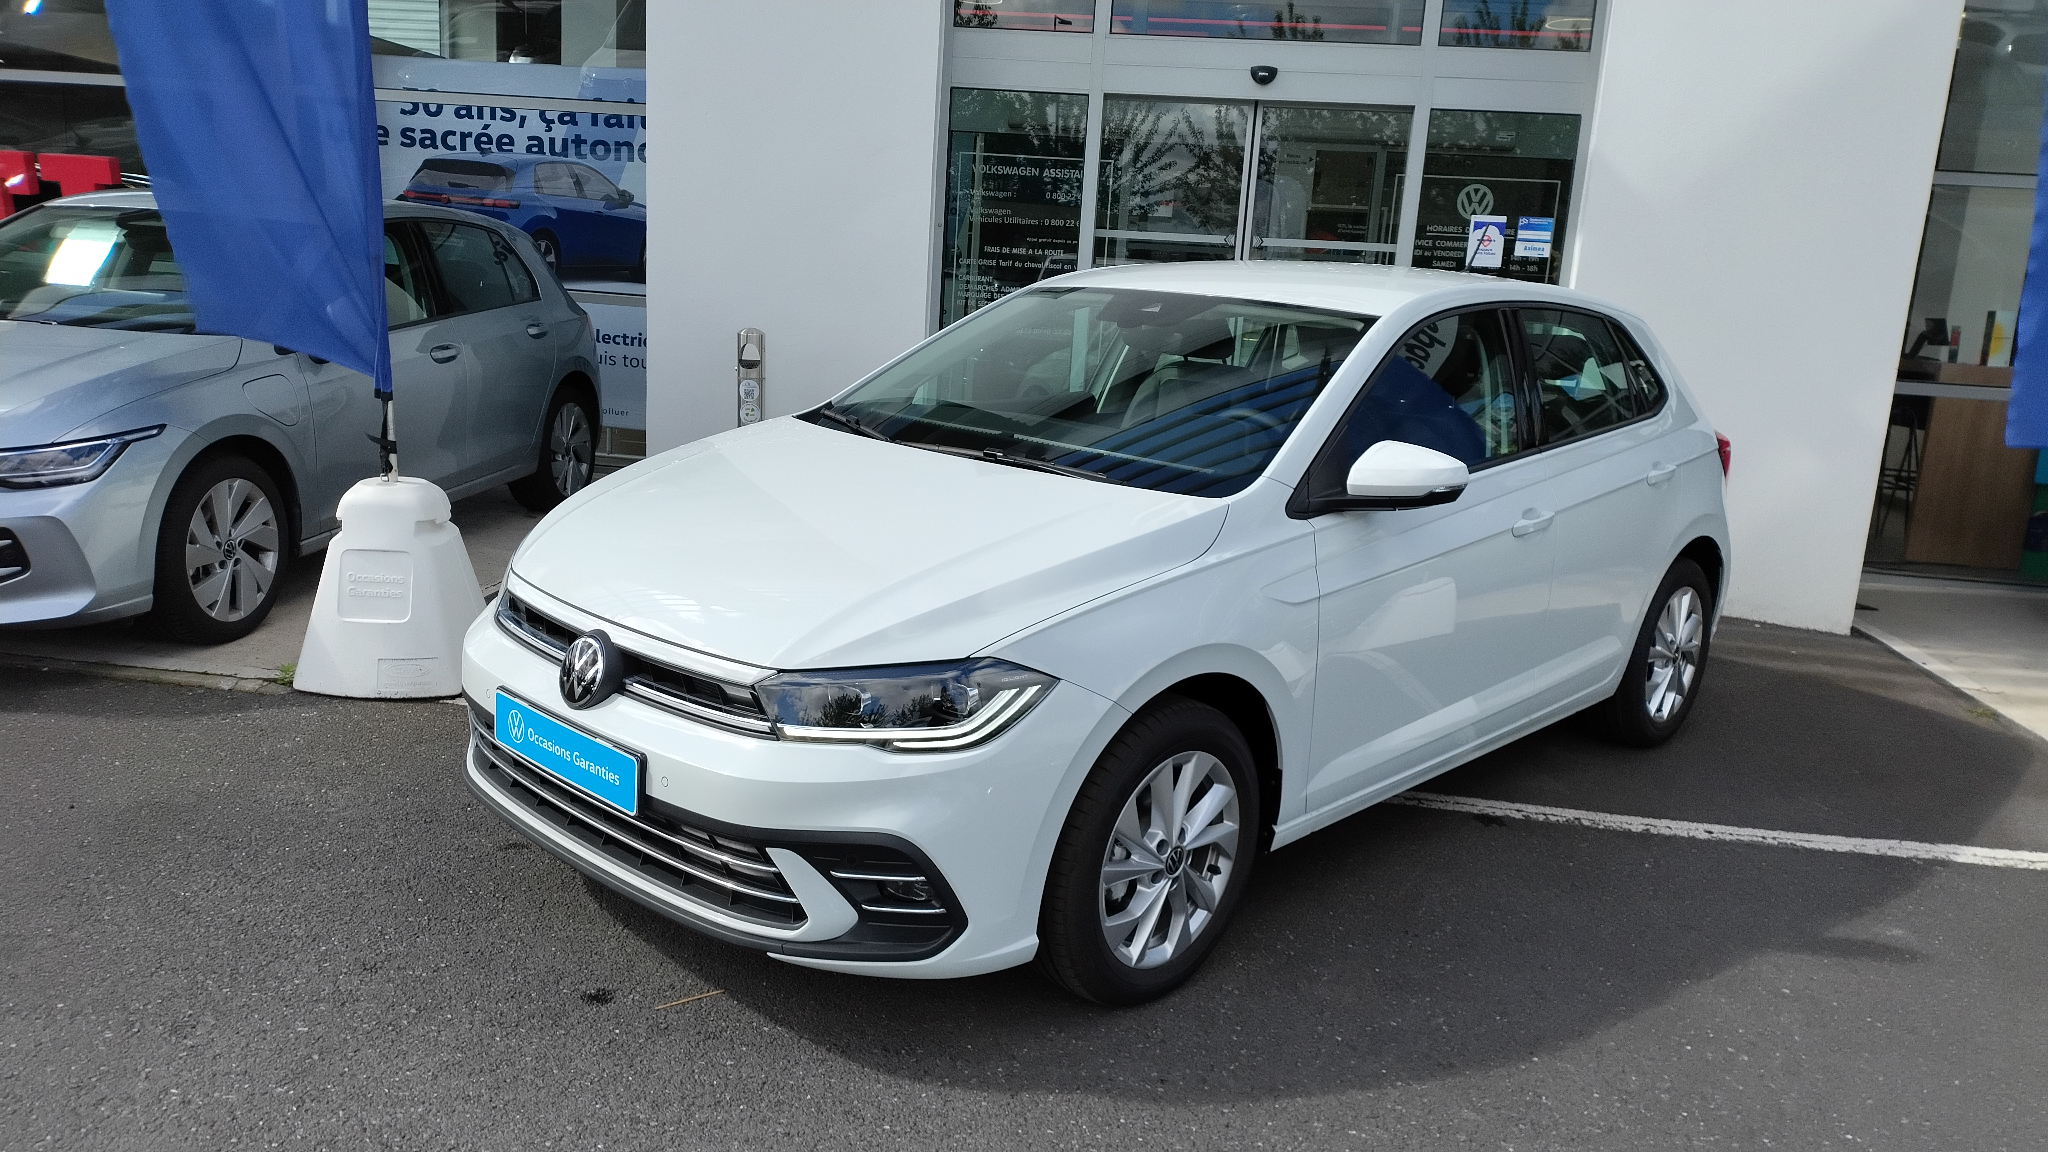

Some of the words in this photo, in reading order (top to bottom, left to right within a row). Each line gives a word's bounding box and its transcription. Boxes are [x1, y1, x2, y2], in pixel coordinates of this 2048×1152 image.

[399, 124, 515, 153] sacrée
[972, 163, 1040, 177] VOLKSWAGEN
[1004, 216, 1039, 225] Utilitaires
[1426, 224, 1463, 233] HORAIRES
[1002, 246, 1010, 254] DE
[1012, 247, 1026, 255] MISE
[1432, 249, 1465, 258] VENDREDI
[978, 258, 997, 266] GRISE
[999, 259, 1012, 267] Tarif
[1024, 260, 1043, 269] cheval
[1432, 260, 1457, 268] SAMEDI
[346, 571, 405, 585] Occasions
[347, 587, 404, 599] Garanties
[527, 727, 572, 762] Occasions
[572, 751, 620, 786] Garanties
